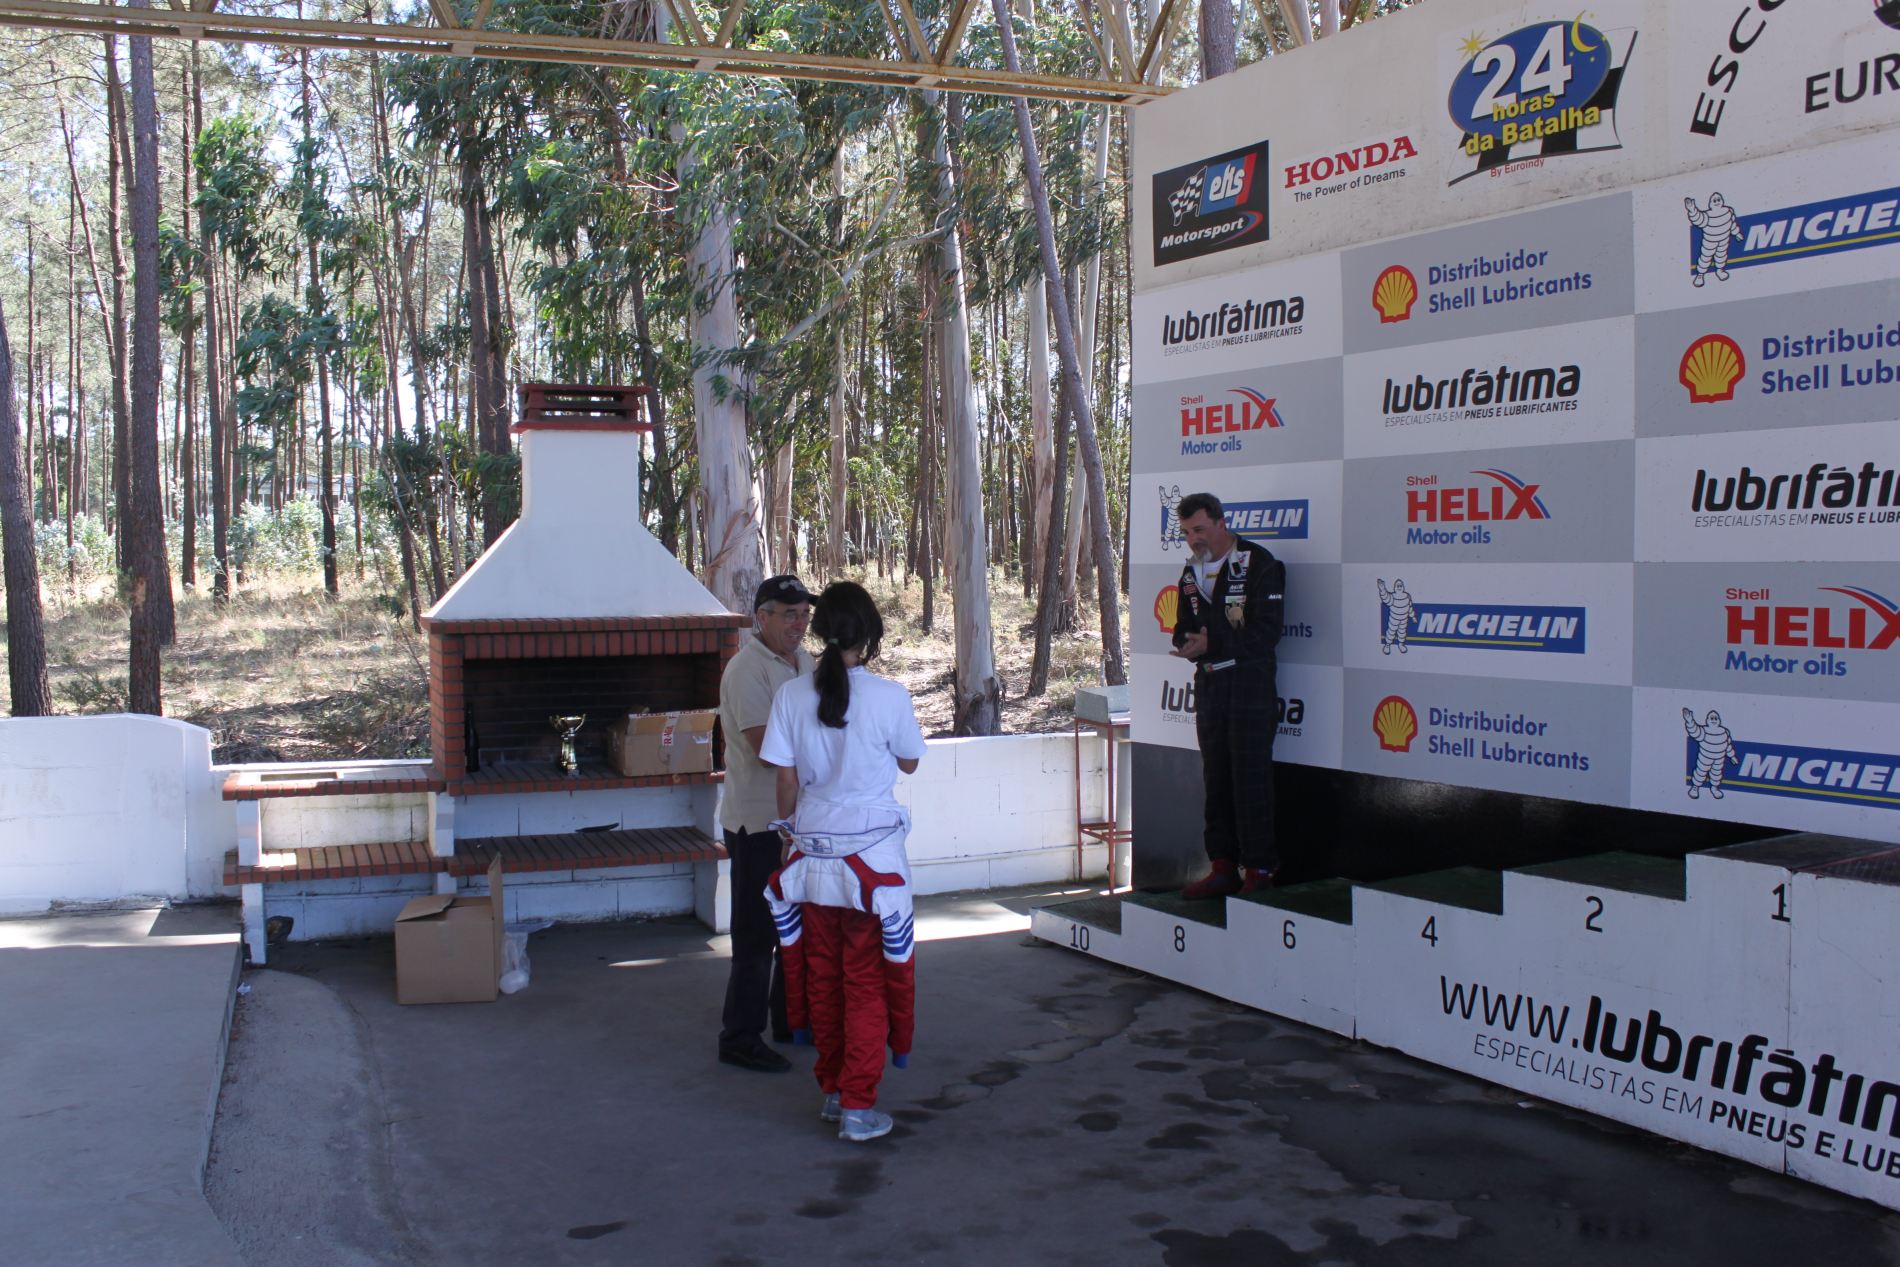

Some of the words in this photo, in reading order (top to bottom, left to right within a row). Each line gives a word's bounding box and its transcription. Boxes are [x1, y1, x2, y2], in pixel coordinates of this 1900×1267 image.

[1471, 24, 1573, 119] 24
[1805, 53, 1900, 113] EUR
[1492, 92, 1556, 122] horas
[1465, 132, 1495, 156] da
[1502, 106, 1600, 146] Batalha
[1284, 135, 1418, 189] HONDA
[1490, 167, 1502, 178] By
[1504, 158, 1545, 174] Euroindy
[1294, 191, 1312, 203] The
[1315, 182, 1347, 198] Power
[1350, 176, 1361, 189] of
[1363, 168, 1406, 186] Dreams
[1160, 217, 1244, 249] Motorsport
[1744, 199, 1900, 252] MICHE
[1429, 248, 1548, 285] Distribuidor
[1429, 287, 1475, 313] Shell
[1483, 271, 1592, 304] Lubricants
[1222, 336, 1243, 347] PNEUS
[1244, 335, 1249, 343] E
[1250, 325, 1303, 342] LUBRIFICANTES
[1762, 321, 1900, 361] Distribuid
[1761, 365, 1829, 394] Shell
[1841, 359, 1900, 387] Lub
[1181, 395, 1203, 406] Shell
[1181, 396, 1281, 437] HELIX
[1384, 412, 1448, 427] ESPECIALISTAS
[1464, 408, 1494, 420] PNEUS
[1496, 407, 1502, 417] E
[1503, 400, 1577, 416] LUBRIFICANTES
[1181, 441, 1218, 455] Motor
[1220, 435, 1242, 452] oils
[1407, 475, 1437, 486] Shell
[1406, 483, 1545, 522] HELIX
[1407, 528, 1457, 544] Motor
[1461, 525, 1491, 544] oils
[1695, 513, 1786, 528] ESPECIALISTAS
[1789, 513, 1808, 526] EM
[1810, 513, 1854, 525] PNEUS
[1857, 512, 1866, 524] E
[1726, 588, 1769, 600] Shell
[1417, 613, 1579, 639] MICHELIN
[1725, 602, 1900, 650] HELIX
[1725, 650, 1798, 674] Motor
[1803, 653, 1847, 677] oils
[1429, 707, 1547, 736] Distribuidor
[1428, 735, 1474, 758] Shell
[1482, 740, 1589, 771] Lubricants
[1585, 896, 1604, 933] 2
[1771, 883, 1790, 922] 1
[1070, 924, 1090, 951] 10
[1174, 925, 1185, 952] 8
[1283, 920, 1296, 949] 6
[1421, 916, 1438, 947] 4
[1474, 1034, 1655, 1104] ESPECIALISTAS
[1662, 1087, 1703, 1119] EM
[1708, 1099, 1806, 1149] PNEUS
[1814, 1130, 1836, 1158] E
